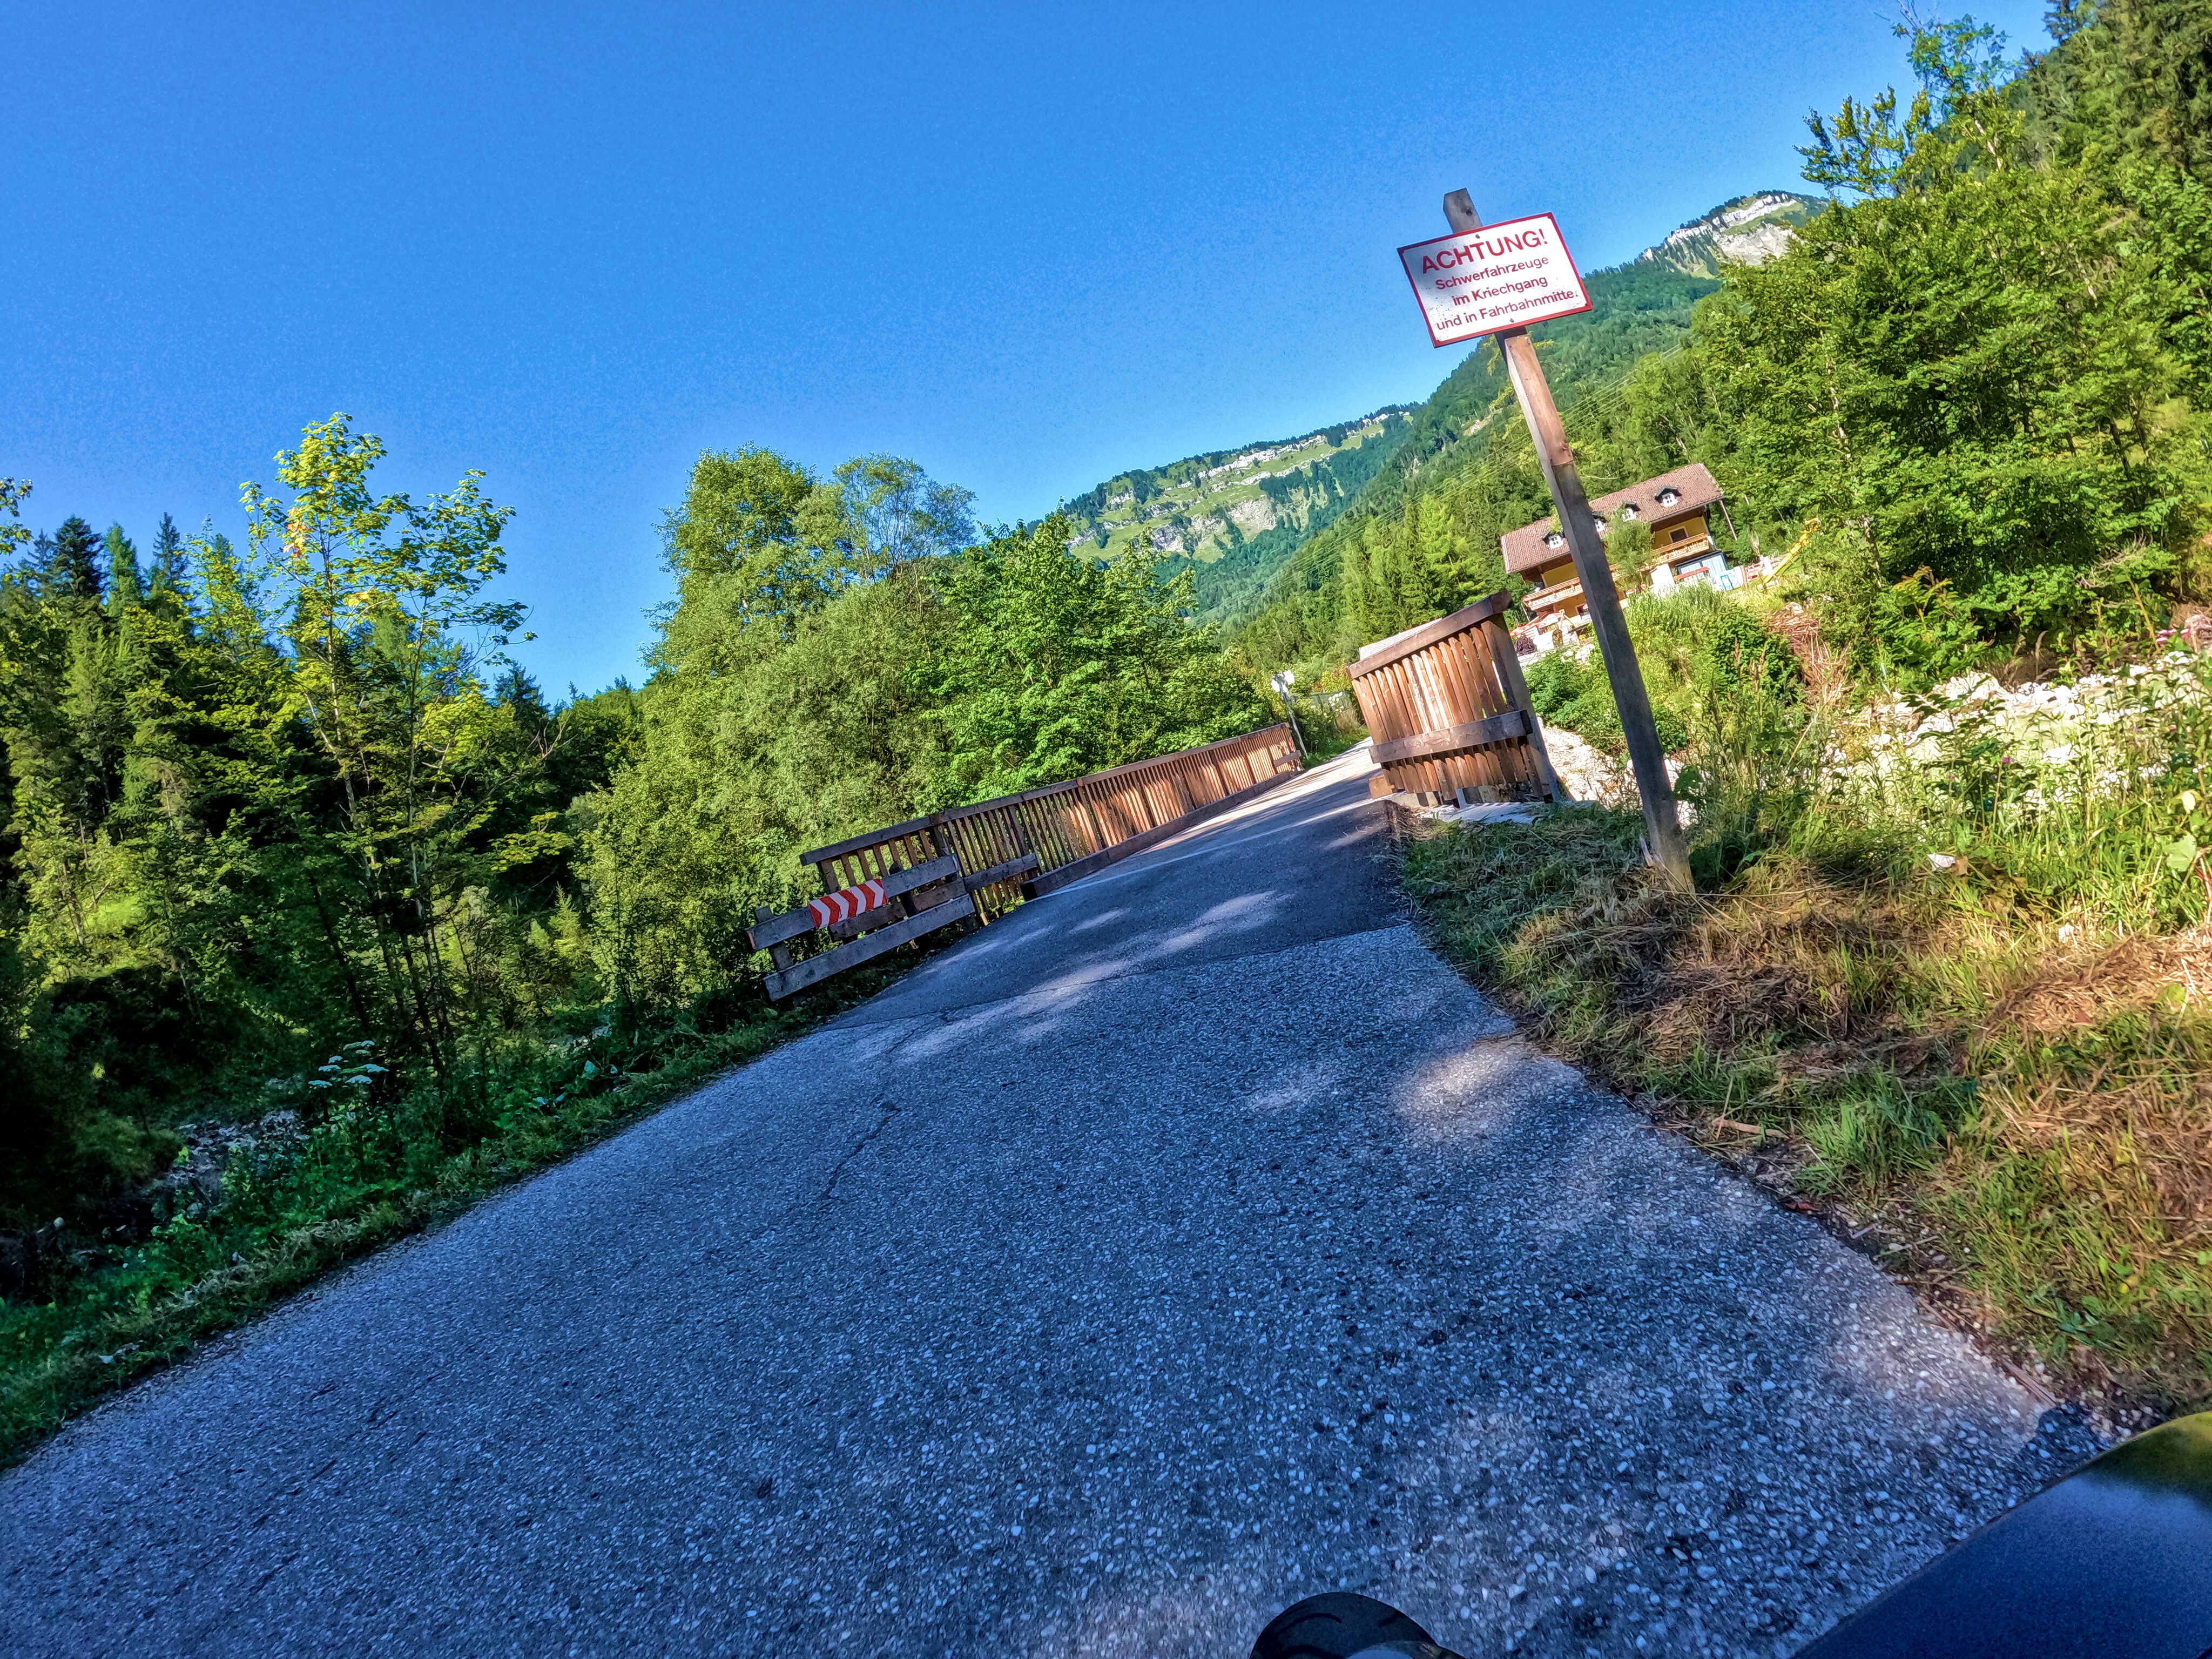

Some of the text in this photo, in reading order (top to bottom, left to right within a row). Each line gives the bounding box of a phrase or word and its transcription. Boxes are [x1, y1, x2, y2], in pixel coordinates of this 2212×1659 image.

[1422, 228, 1548, 274] ACHTUNG!
[1435, 257, 1549, 290] Schwerfahrzeuge
[1452, 276, 1548, 306] im Kriechgang
[1436, 315, 1462, 331] und
[1464, 313, 1478, 324] in
